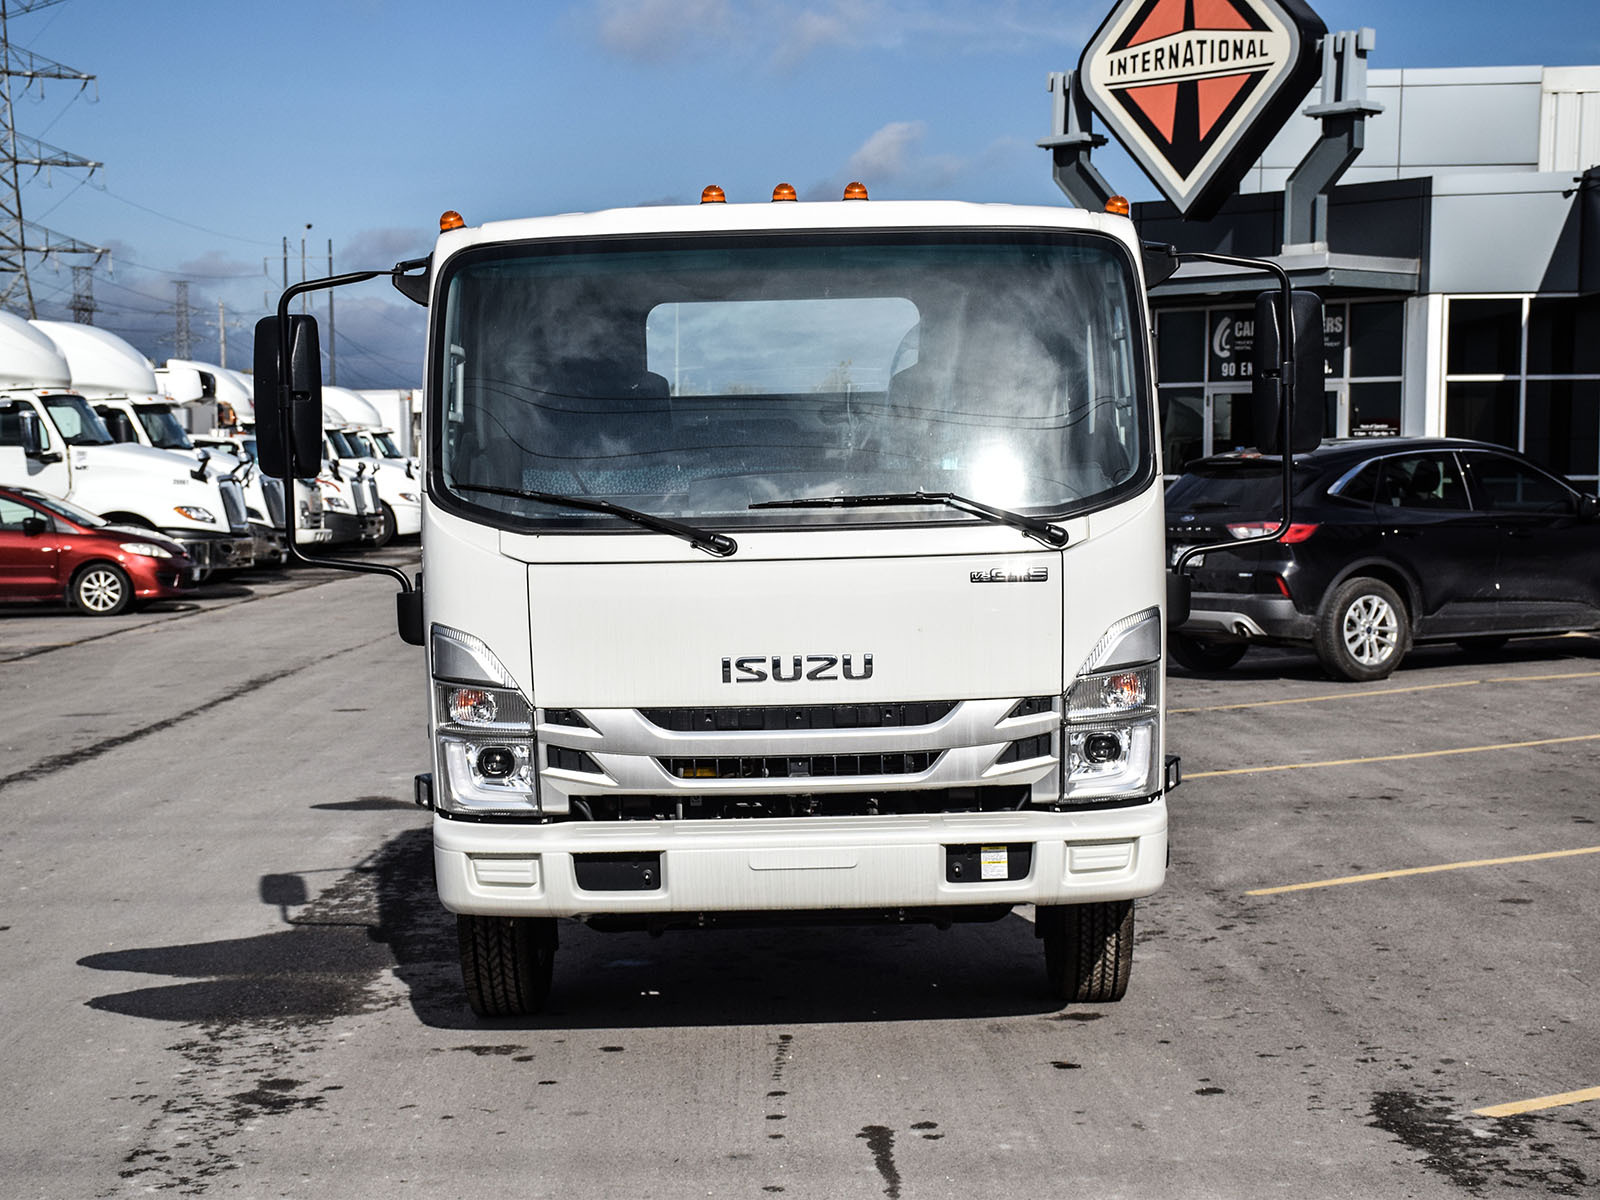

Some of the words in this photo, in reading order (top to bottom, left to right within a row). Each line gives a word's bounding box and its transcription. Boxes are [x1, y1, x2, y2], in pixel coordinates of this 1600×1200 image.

[1110, 39, 1269, 76] INTERNATIONAL
[1221, 362, 1236, 376] 90
[721, 653, 873, 683] ISUZU
